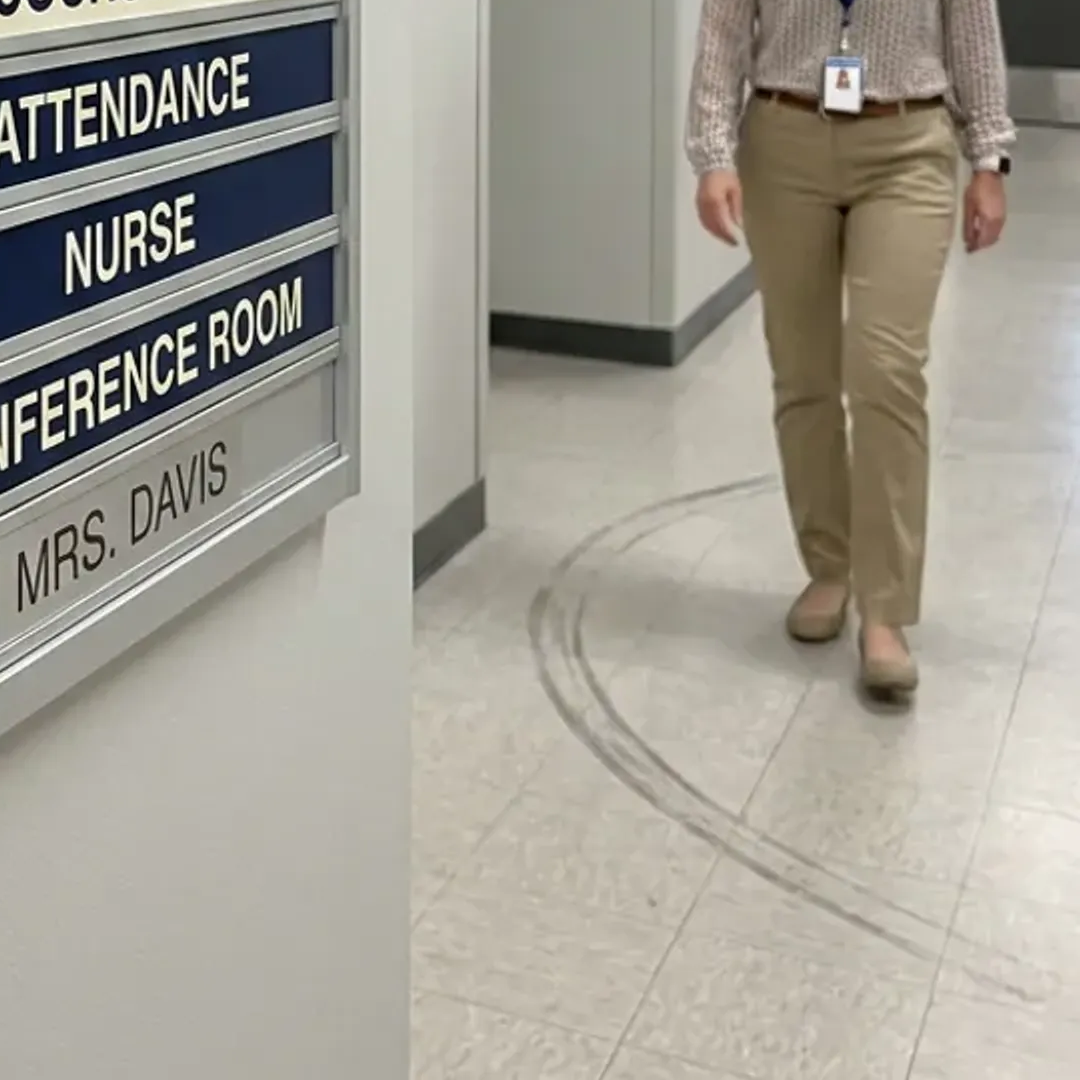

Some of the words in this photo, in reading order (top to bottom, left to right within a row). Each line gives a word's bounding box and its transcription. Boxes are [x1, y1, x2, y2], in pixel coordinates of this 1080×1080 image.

[63, 193, 196, 295] NURSE
[208, 276, 303, 370] ROOM
[17, 509, 116, 612] MRS.
[130, 441, 228, 546] DAVIS
